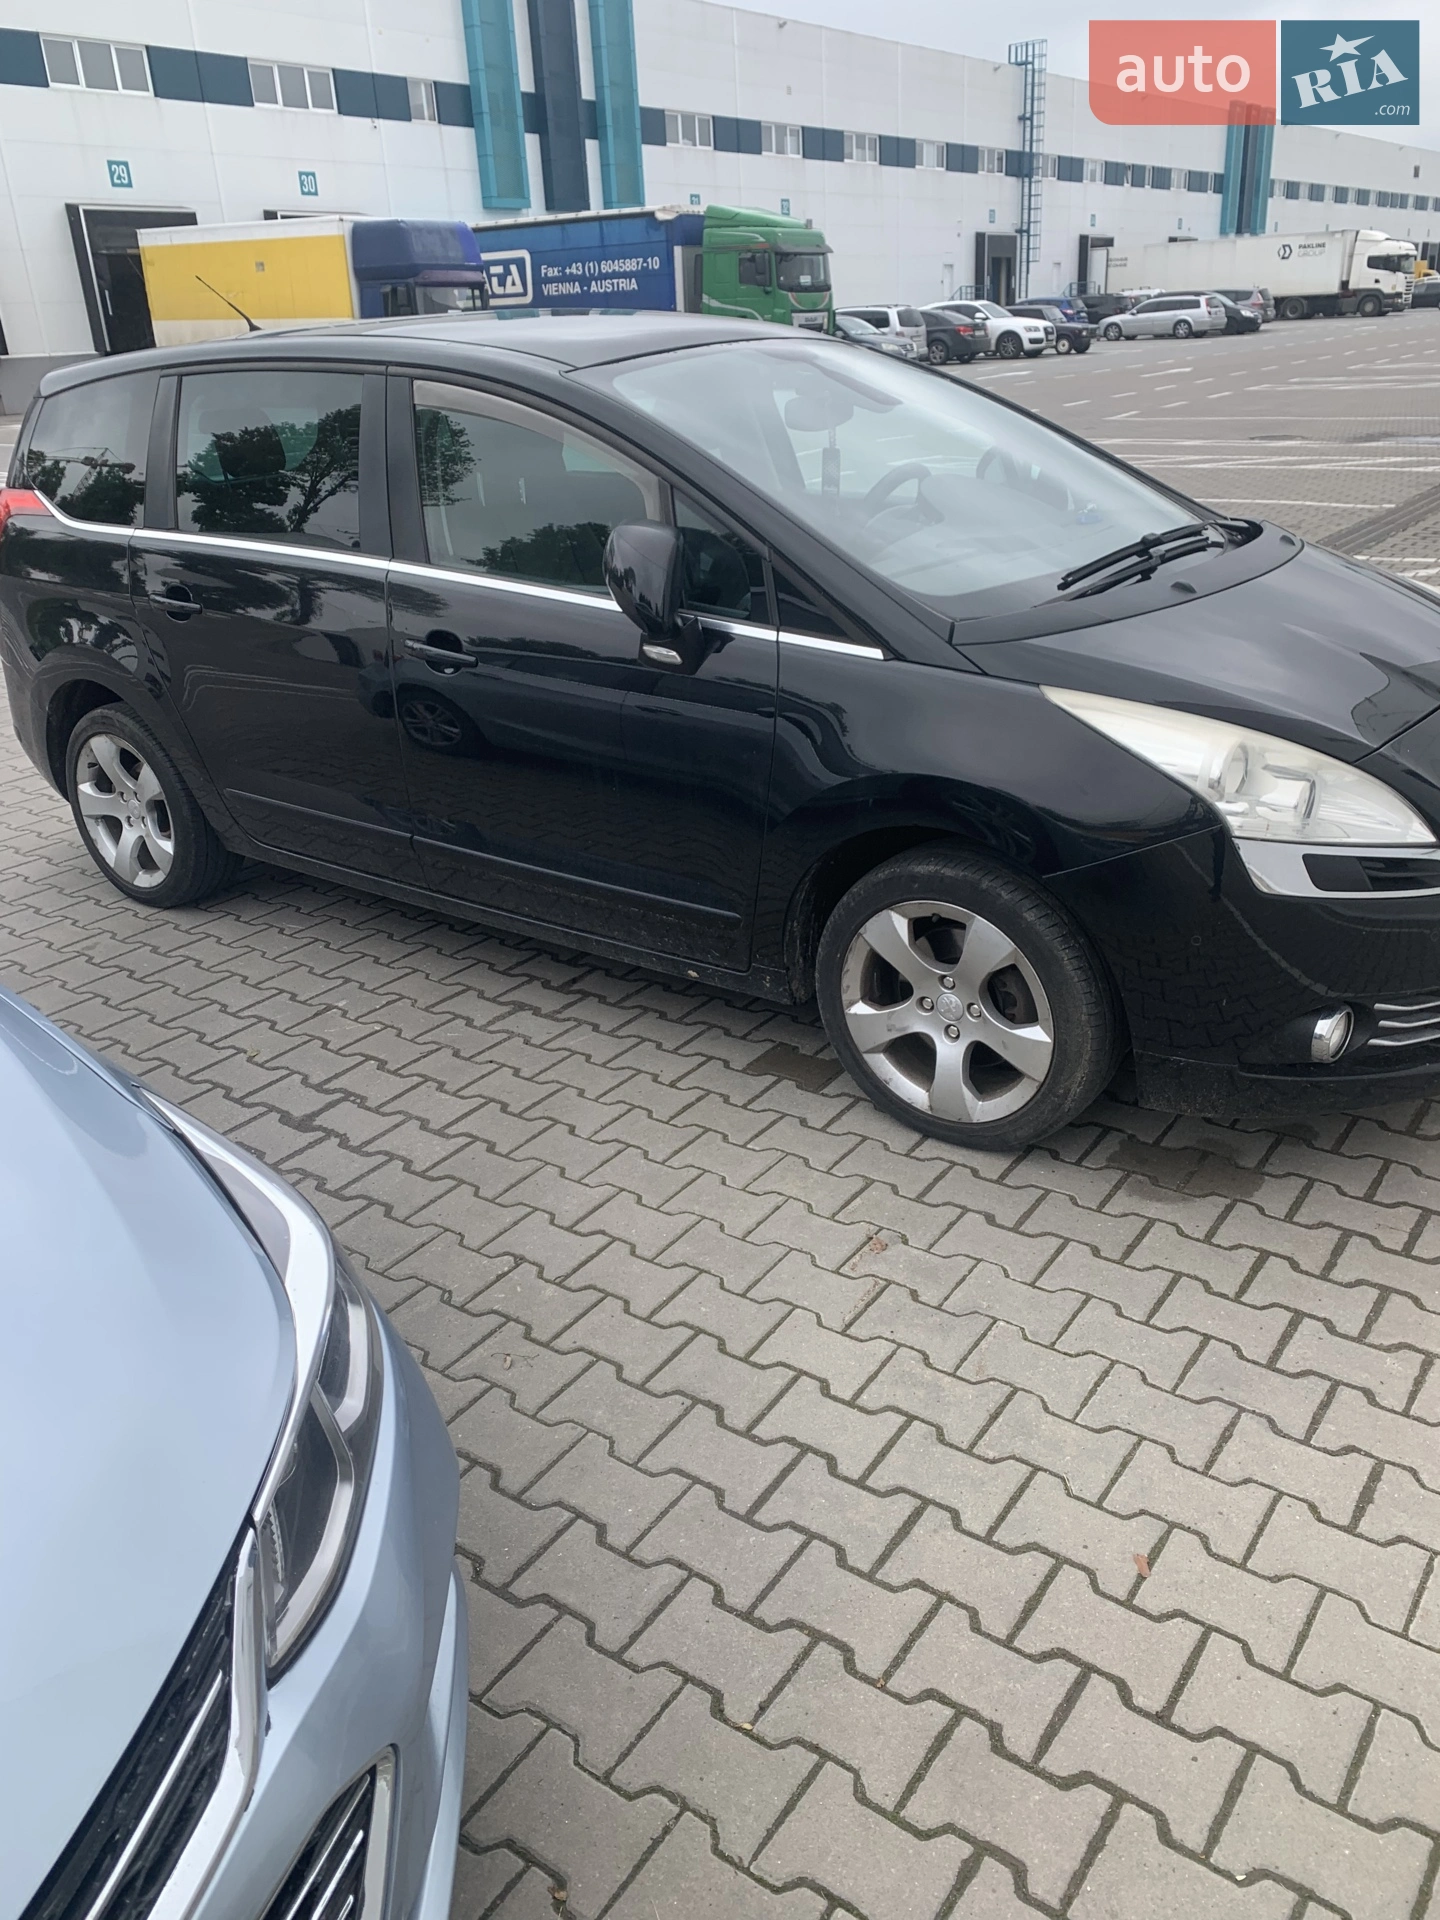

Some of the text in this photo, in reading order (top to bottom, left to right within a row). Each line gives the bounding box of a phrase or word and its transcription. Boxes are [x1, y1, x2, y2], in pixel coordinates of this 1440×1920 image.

[111, 164, 129, 184] 29
[301, 174, 316, 192] 30
[1297, 249, 1326, 257] GROUP
[1298, 242, 1327, 250] PAKLINE
[541, 256, 660, 278] Fax: +43 (1) 6045887-10
[542, 281, 581, 296] VIENNA
[590, 278, 638, 293] AUSTRIA
